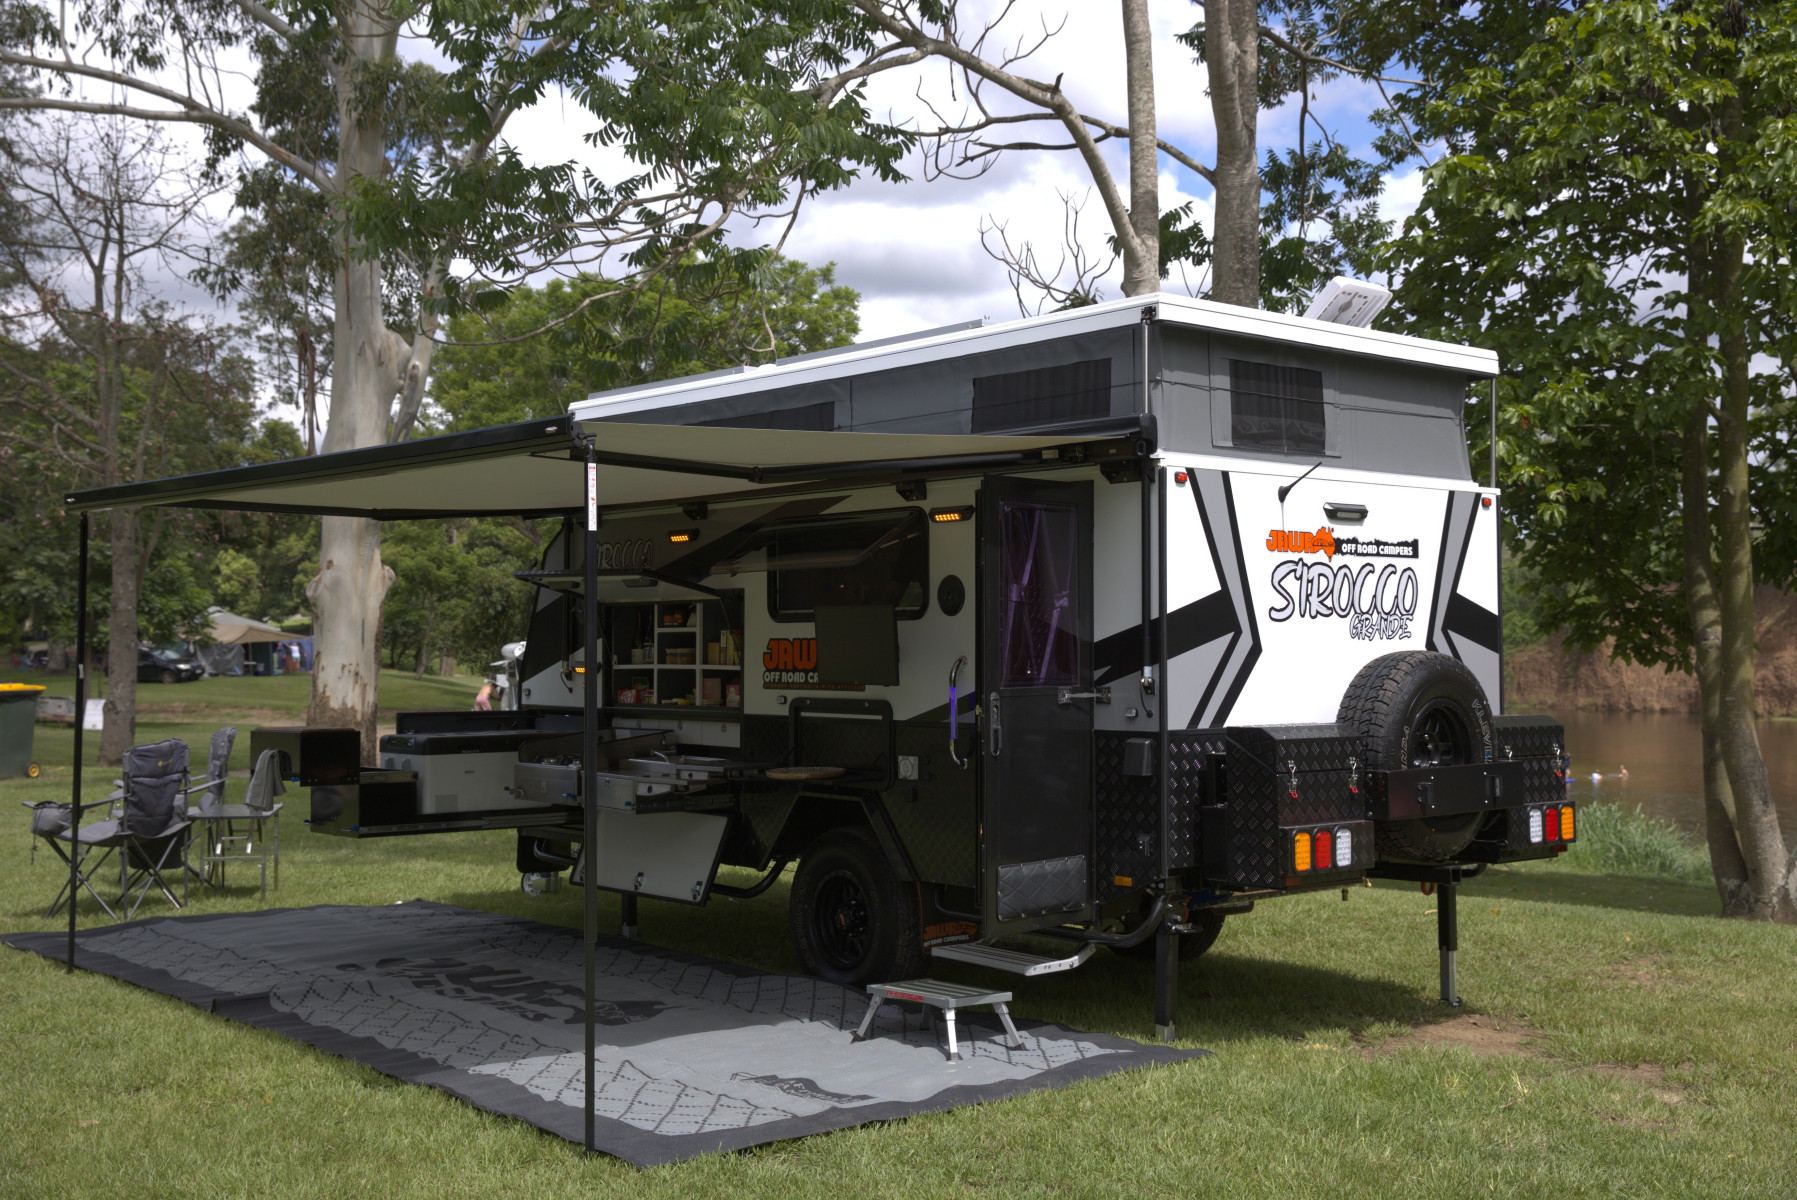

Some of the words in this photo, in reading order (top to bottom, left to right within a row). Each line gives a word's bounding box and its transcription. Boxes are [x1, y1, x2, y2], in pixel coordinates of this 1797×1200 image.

[597, 538, 654, 569] IROCCO
[1266, 530, 1315, 553] JAWA
[1342, 543, 1356, 553] OFF
[1357, 544, 1378, 554] ROAD
[1379, 545, 1413, 556] CAMPERS
[1268, 557, 1419, 622] SIROCCO
[1349, 613, 1414, 641] GRANDE
[763, 638, 817, 670] JAW
[764, 671, 781, 683] OFF
[783, 672, 806, 683] ROAD
